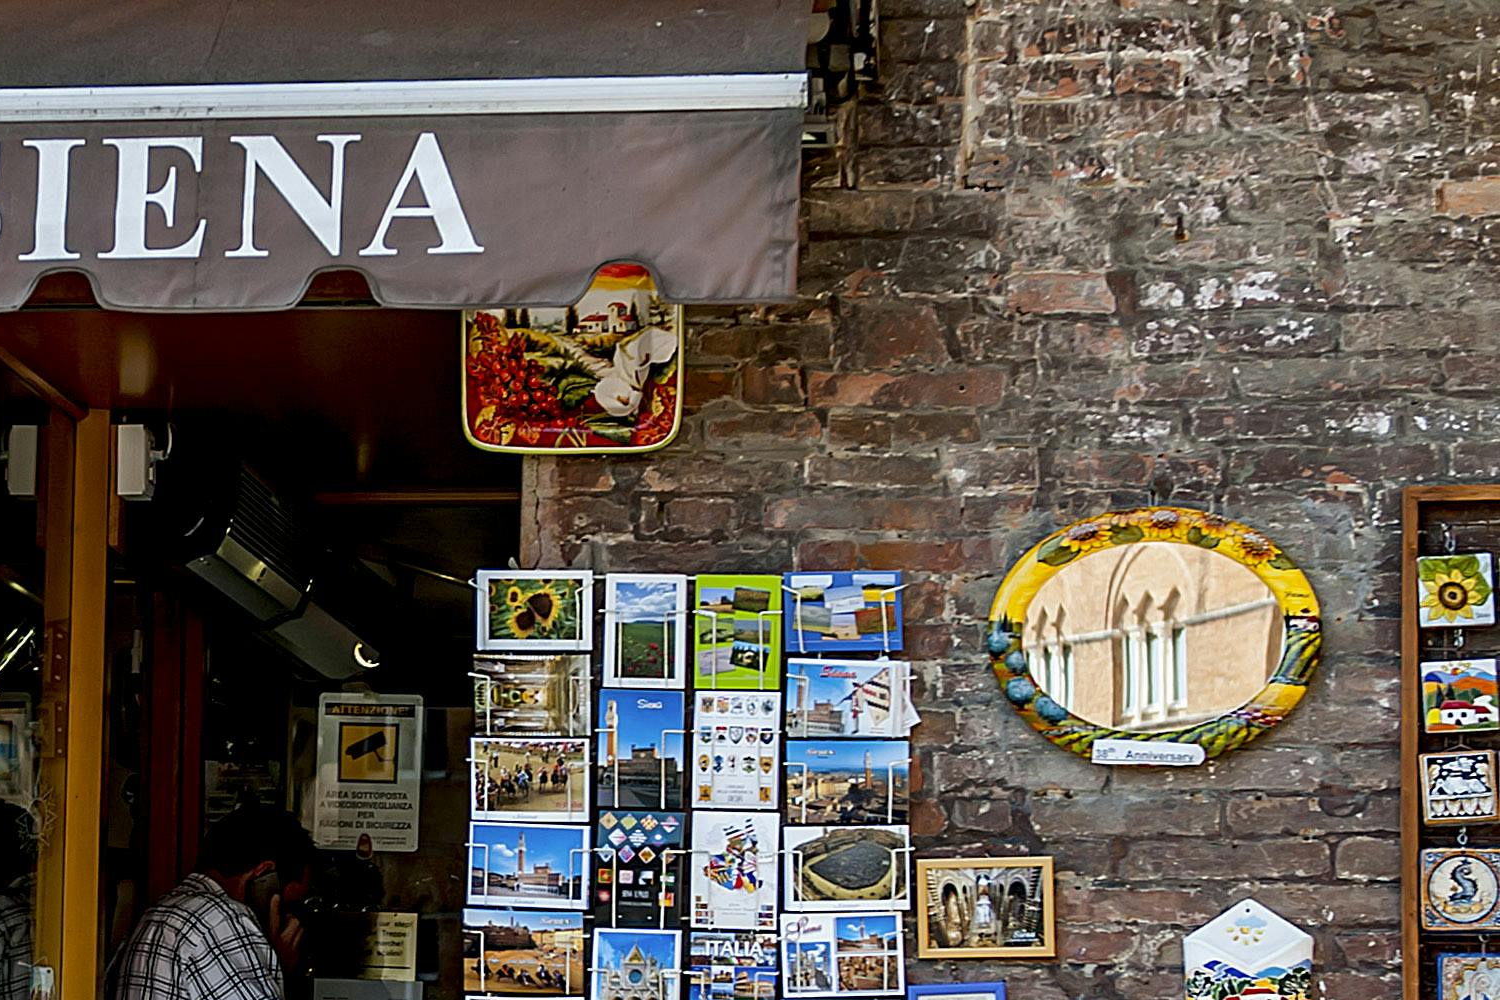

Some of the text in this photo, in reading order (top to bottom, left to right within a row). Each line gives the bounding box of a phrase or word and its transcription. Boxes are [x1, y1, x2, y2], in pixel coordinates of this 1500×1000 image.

[331, 705, 406, 715] ATTENZIONE
[1125, 749, 1194, 763] Anniversary
[351, 791, 408, 800] SOTTOPOSTA
[357, 811, 375, 819] PER
[355, 820, 365, 829] DI
[366, 820, 412, 830] SICUREZZA
[785, 915, 822, 941] Siena
[704, 939, 764, 957] ITALIA
